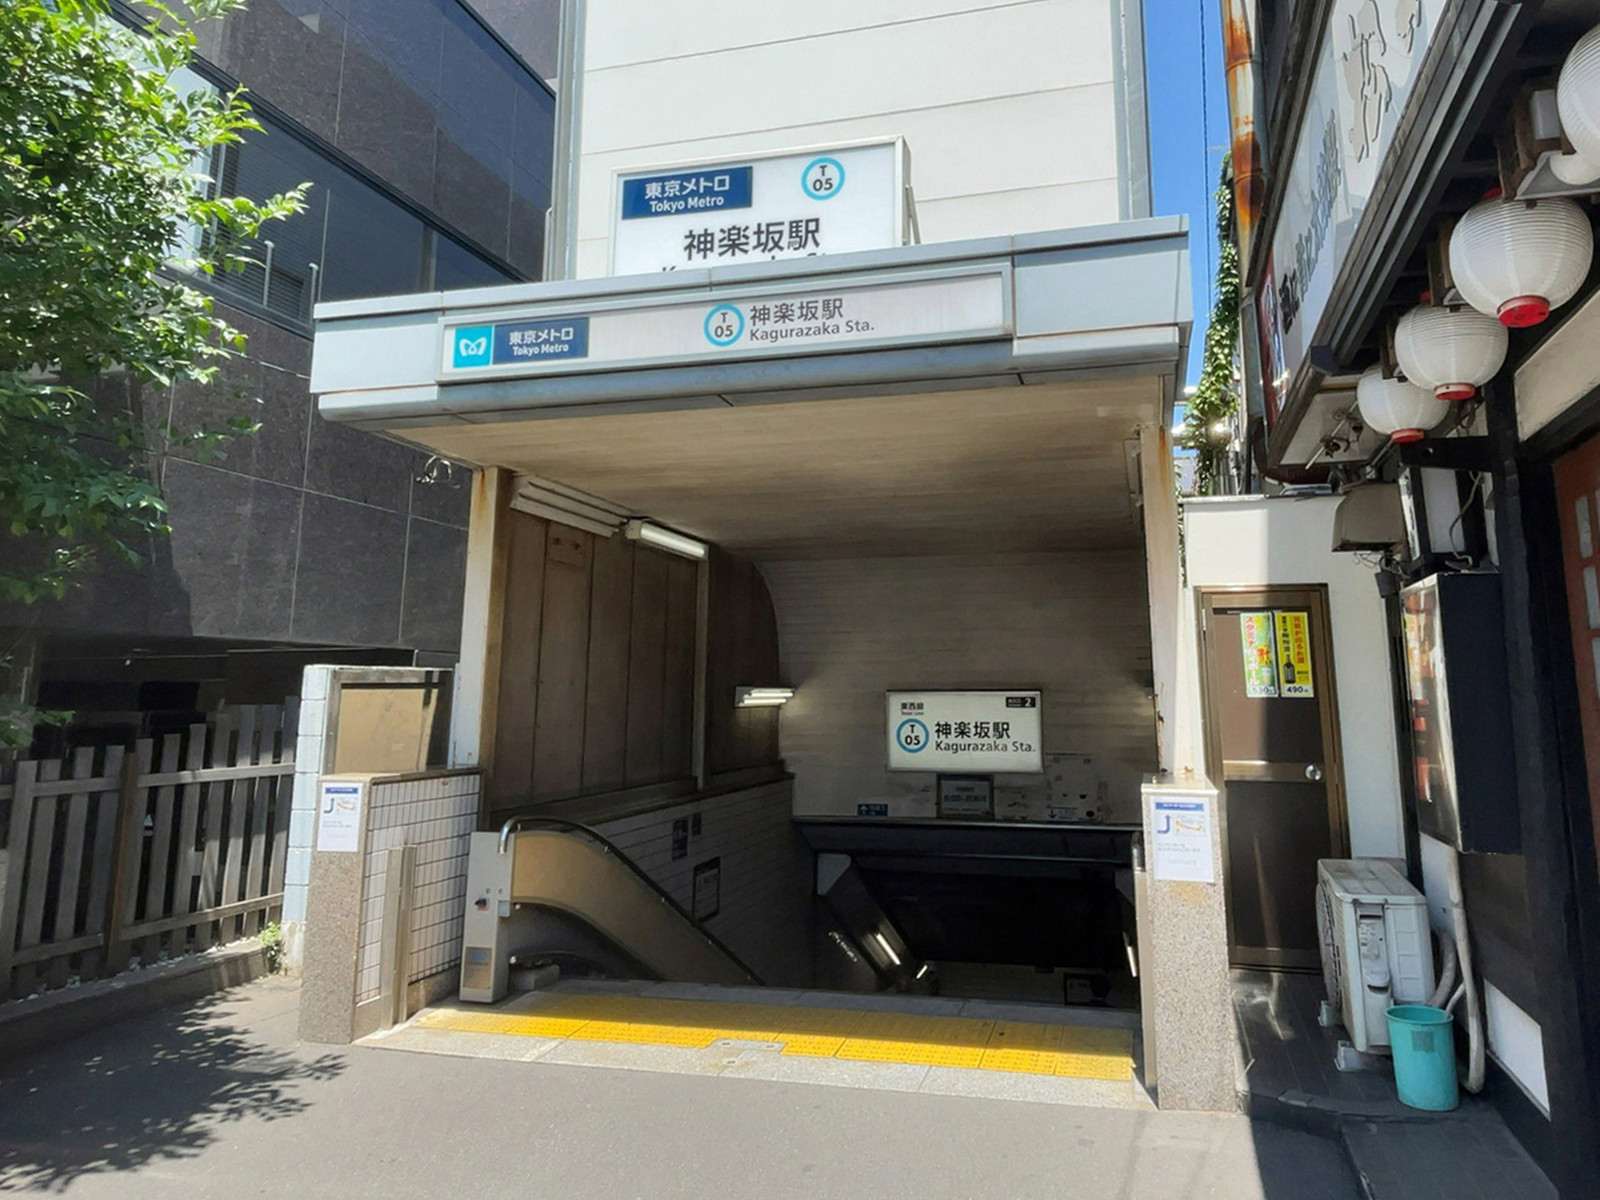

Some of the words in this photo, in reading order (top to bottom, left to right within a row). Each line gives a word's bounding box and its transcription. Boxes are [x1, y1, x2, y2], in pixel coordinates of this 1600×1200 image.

[818, 165, 828, 177] T
[644, 174, 731, 200] 東京メトロ
[812, 178, 834, 192] 05
[649, 199, 686, 213] Tokyo
[687, 195, 725, 209] Metro
[683, 217, 821, 262] 神楽坂駅
[720, 312, 729, 323] T
[749, 298, 844, 328] 神楽坂駅
[508, 327, 574, 347] 東京メトロ
[714, 324, 735, 340] 05
[749, 320, 841, 345] Kagurazaka
[845, 317, 875, 335] Sta.
[512, 344, 538, 358] Tokyo
[538, 342, 570, 355] Metro
[1025, 697, 1032, 707] 2
[910, 724, 916, 734] T
[935, 721, 1010, 740] 神楽坂駅
[904, 735, 921, 746] 05
[935, 741, 1008, 754] Kagurazaka
[1012, 741, 1035, 752] Sta.
